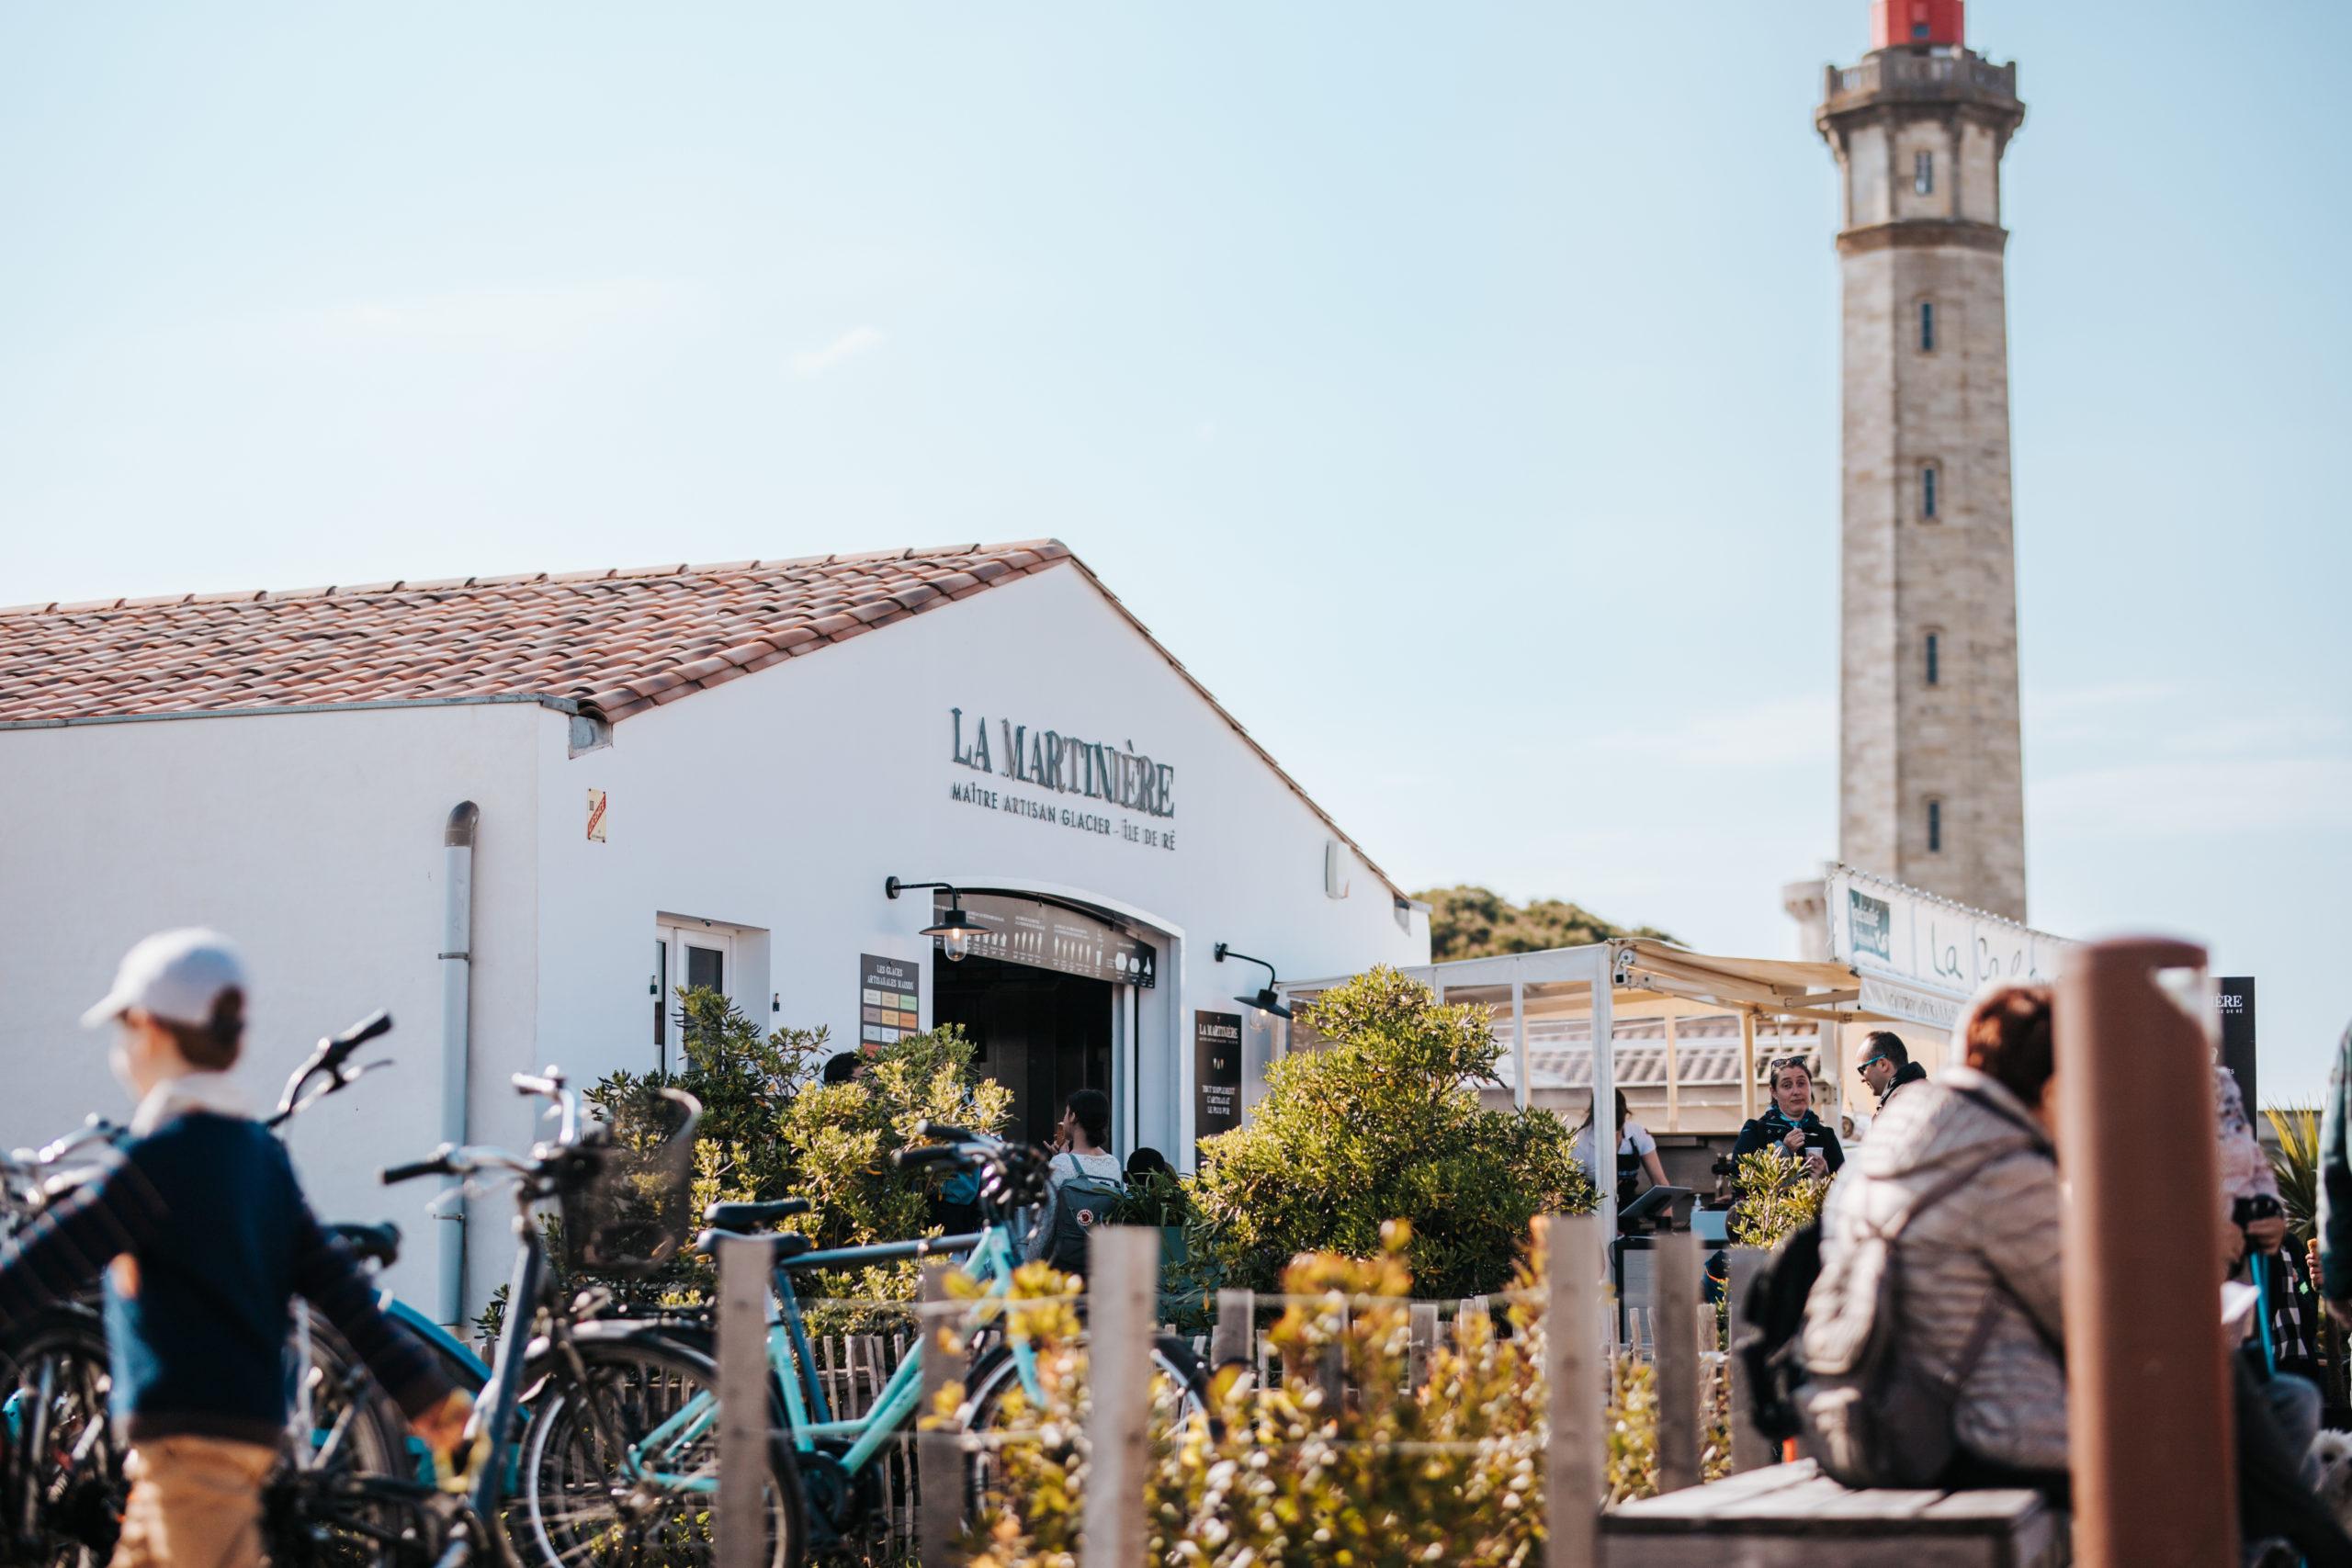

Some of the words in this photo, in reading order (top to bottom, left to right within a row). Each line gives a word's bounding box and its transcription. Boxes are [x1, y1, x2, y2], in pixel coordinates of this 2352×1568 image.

[951, 707, 992, 773] LA
[1001, 717, 1175, 819] MARTINIÈRE
[952, 782, 998, 809] MAÎTRE
[1004, 795, 1056, 824] ARTISAN
[1061, 809, 1111, 836] GLACIER
[1123, 818, 1139, 842] ÎLE
[1145, 829, 1158, 847] DE
[1162, 829, 1175, 851] RÉ
[876, 964, 886, 975] LES
[886, 966, 903, 977] GLACES
[1199, 1023, 1207, 1035] LA
